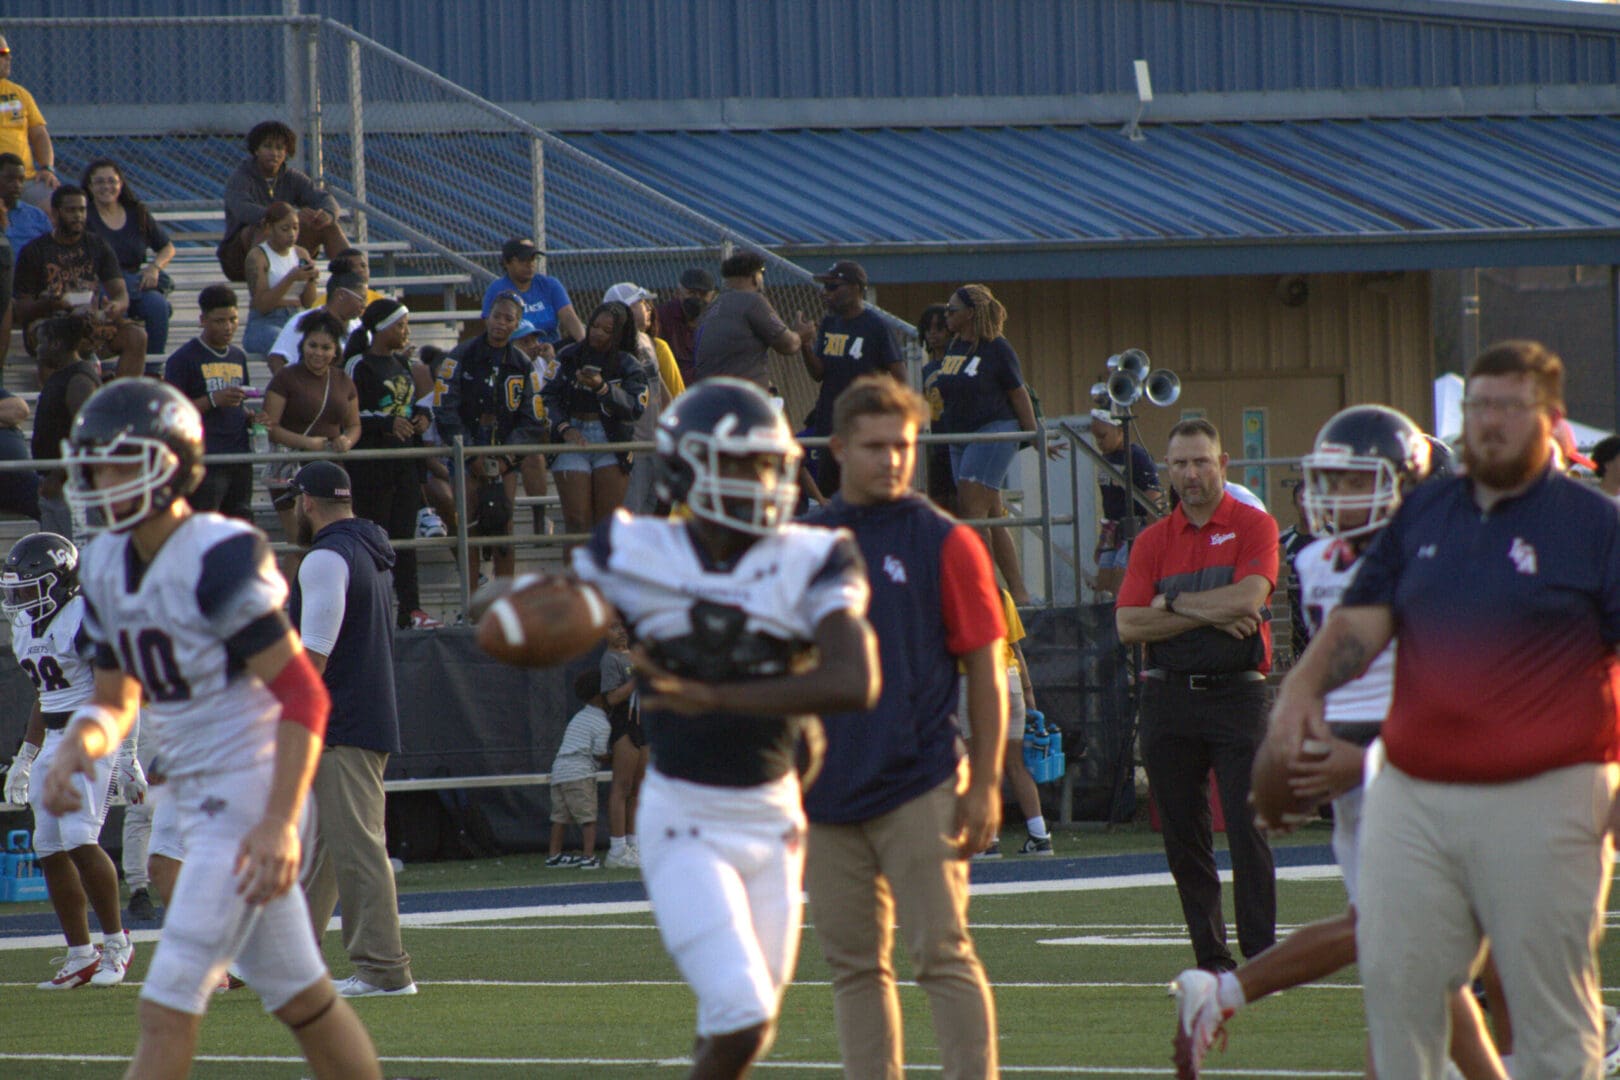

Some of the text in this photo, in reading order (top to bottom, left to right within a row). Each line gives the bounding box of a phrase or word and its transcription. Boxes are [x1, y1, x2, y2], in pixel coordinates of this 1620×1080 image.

[849, 336, 864, 359] 4
[964, 355, 981, 377] 4
[505, 375, 525, 412] C
